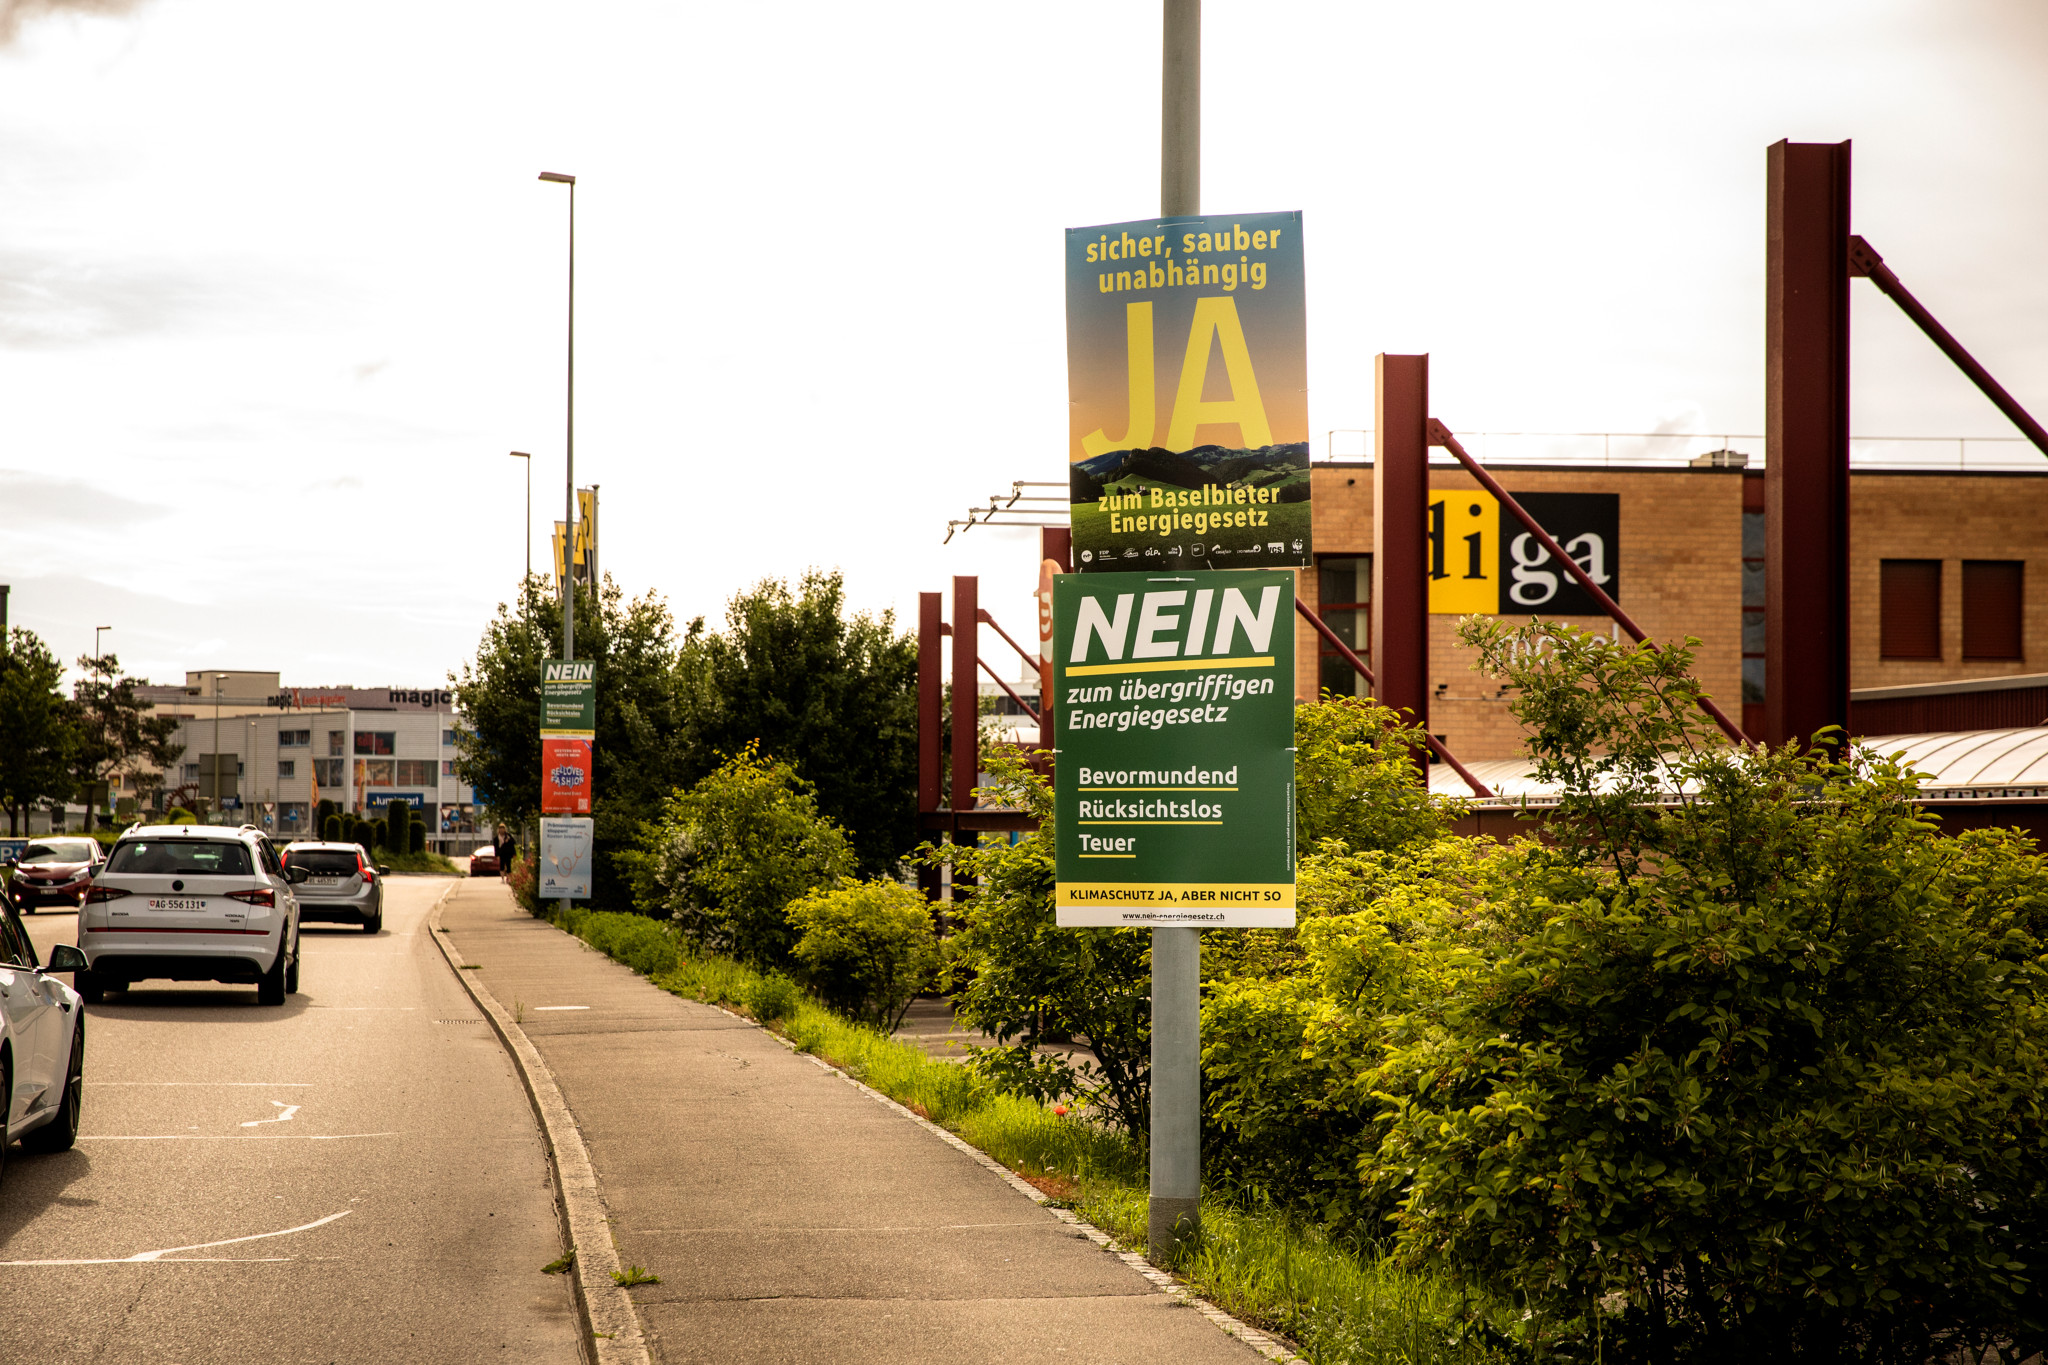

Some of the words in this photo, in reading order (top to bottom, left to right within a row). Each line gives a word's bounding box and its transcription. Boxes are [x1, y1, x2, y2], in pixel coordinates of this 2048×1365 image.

[1086, 232, 1172, 262] sicher,
[1182, 224, 1281, 252] sauber
[1100, 256, 1266, 293] unabhängig
[1081, 296, 1273, 454] JA
[1098, 493, 1142, 512] zum
[1150, 484, 1280, 507] Baselbieter
[1111, 508, 1268, 536] Energiegesetz
[1070, 586, 1281, 662] NEIN
[545, 664, 594, 680] NEIN
[390, 689, 452, 707] magic
[1066, 686, 1112, 704] zum
[1120, 674, 1274, 702] übergriffigen
[1069, 704, 1229, 732] Energiegesetz
[551, 776, 584, 786] FASHION
[1079, 766, 1238, 785] Bevormundend
[1079, 799, 1222, 818] Rücksichtslos
[1078, 834, 1136, 852] Teuer
[1, 846, 13, 862] P
[1070, 890, 1154, 900] KLIMASCHUTZ
[1158, 890, 1177, 902] JA,
[1181, 890, 1216, 900] ABER
[1220, 891, 1260, 901] NICHT
[1264, 891, 1282, 901] SO
[1122, 912, 1225, 921] www.nein-energiegesetz.ch
